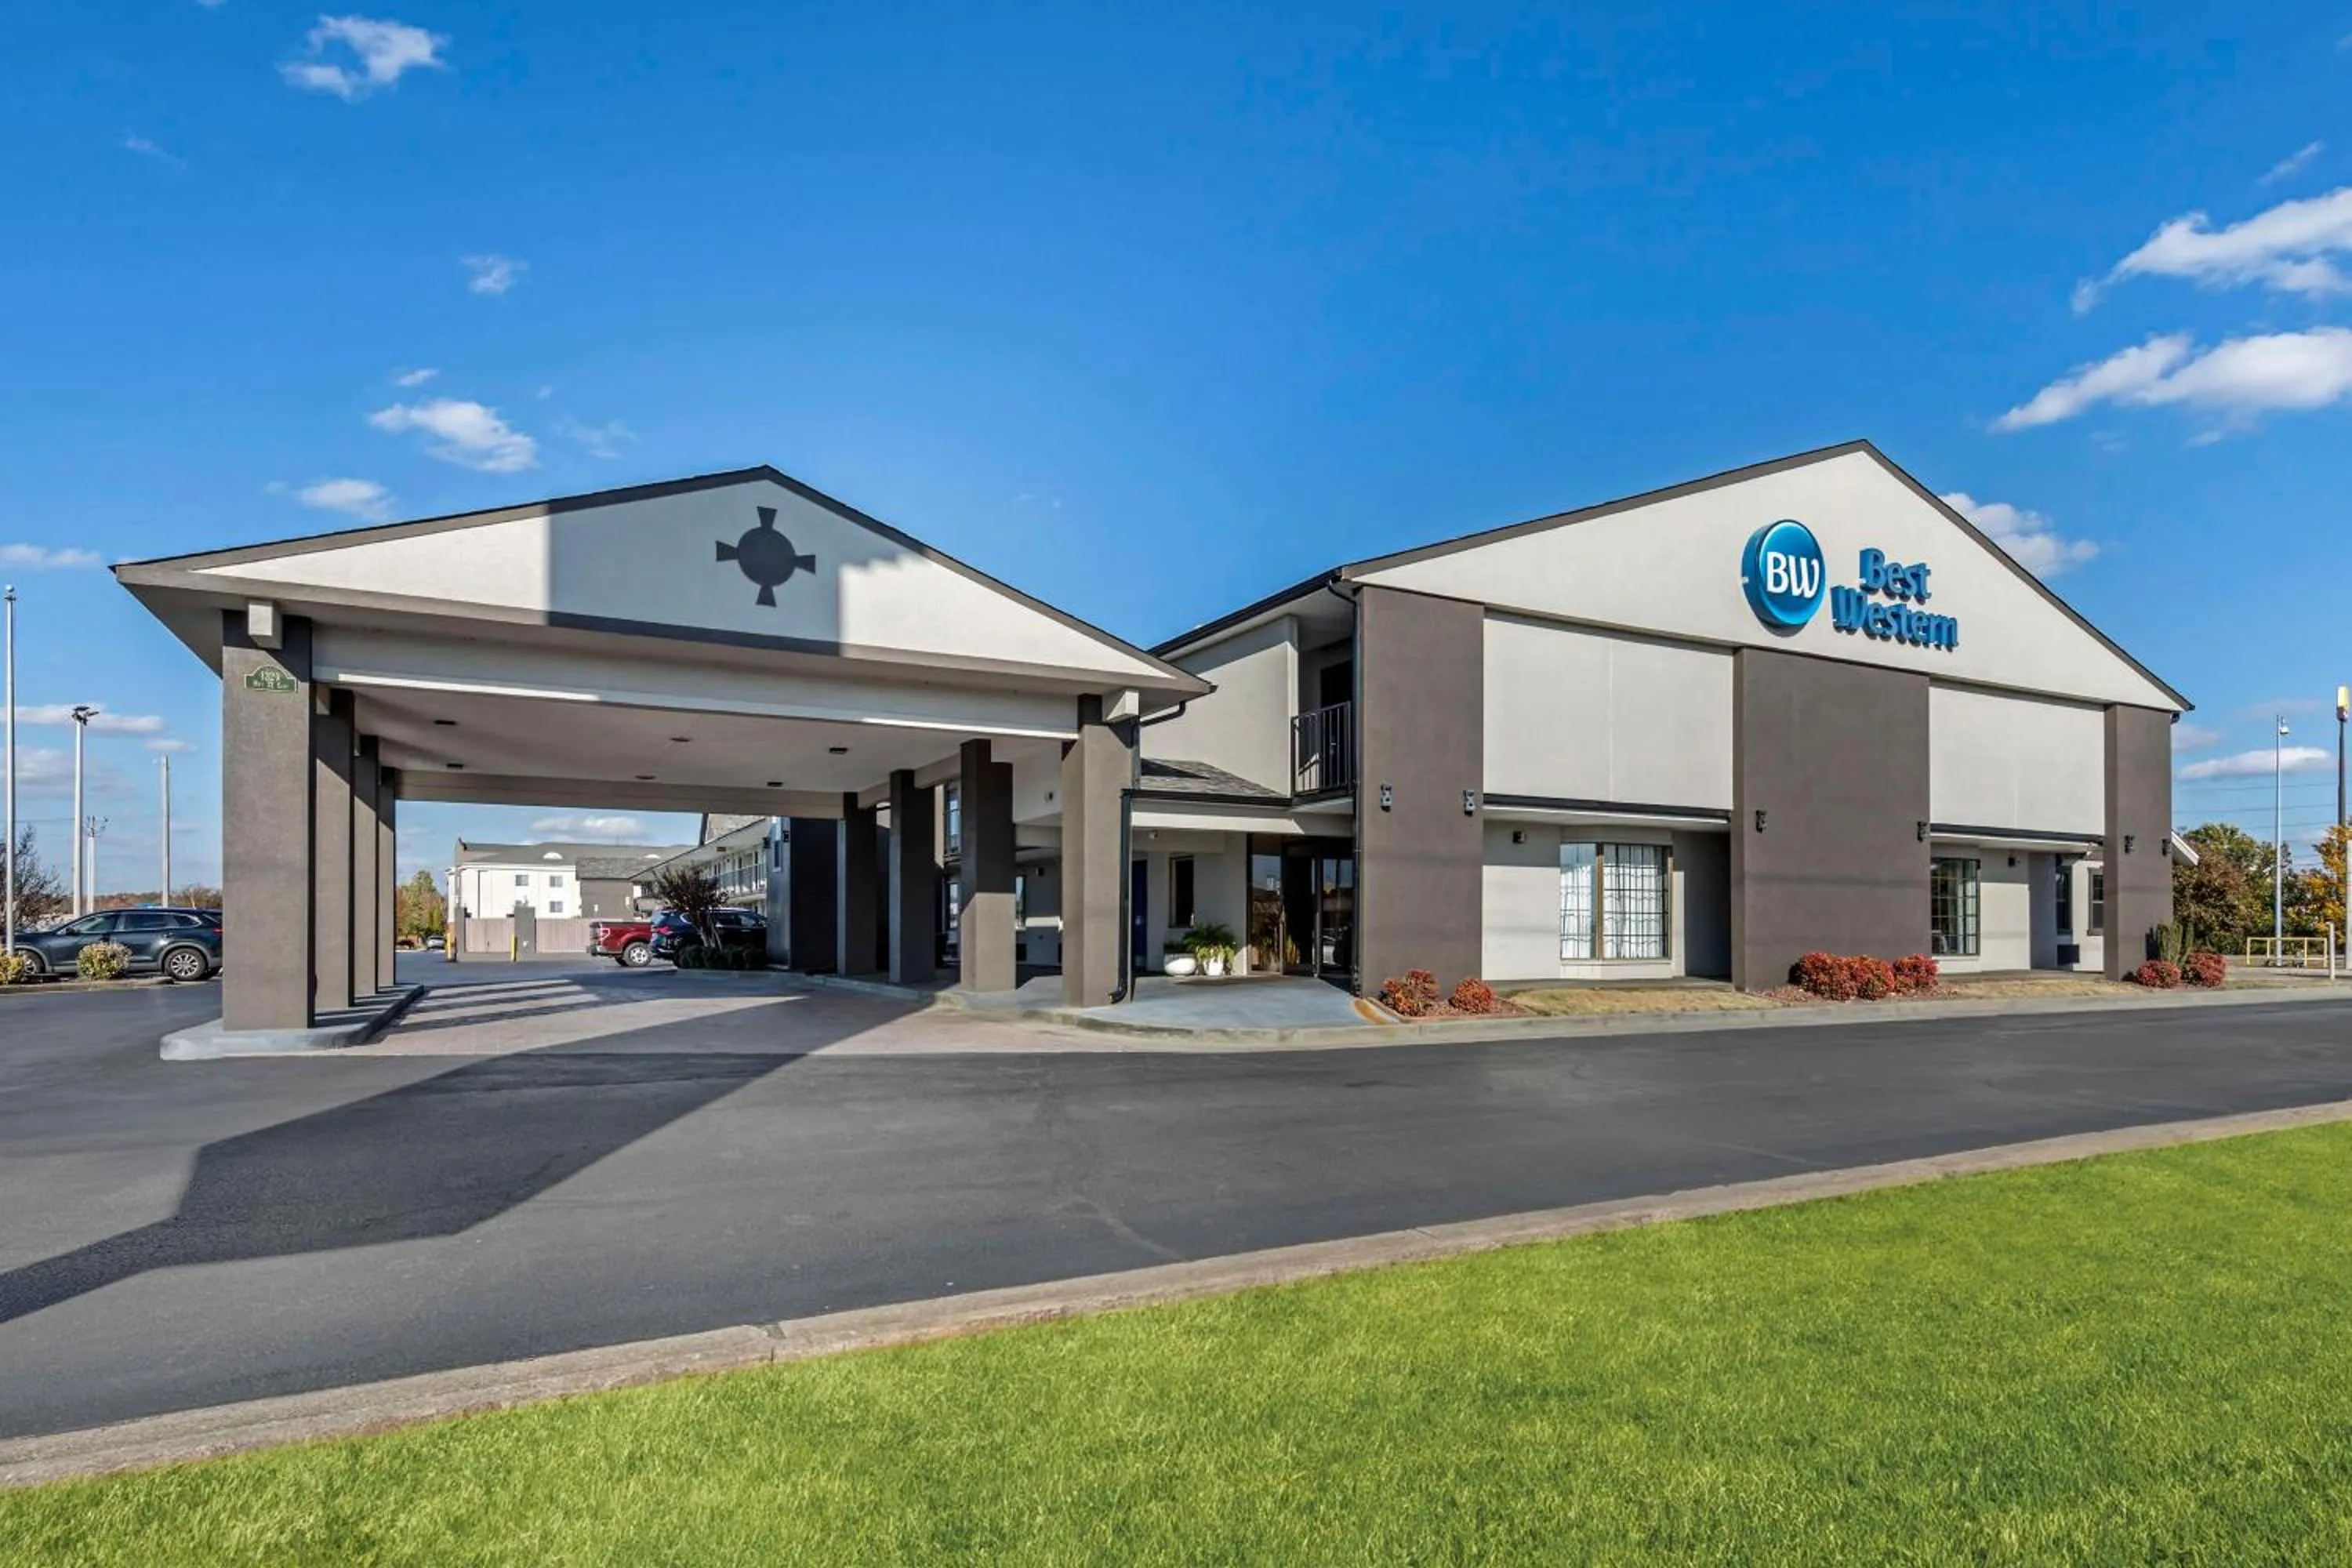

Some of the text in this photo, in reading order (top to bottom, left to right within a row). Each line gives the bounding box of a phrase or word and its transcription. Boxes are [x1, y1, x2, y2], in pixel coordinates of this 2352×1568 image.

[1766, 551, 1820, 598] BW
[1859, 547, 1931, 601] Best
[1830, 585, 1959, 649] Western
